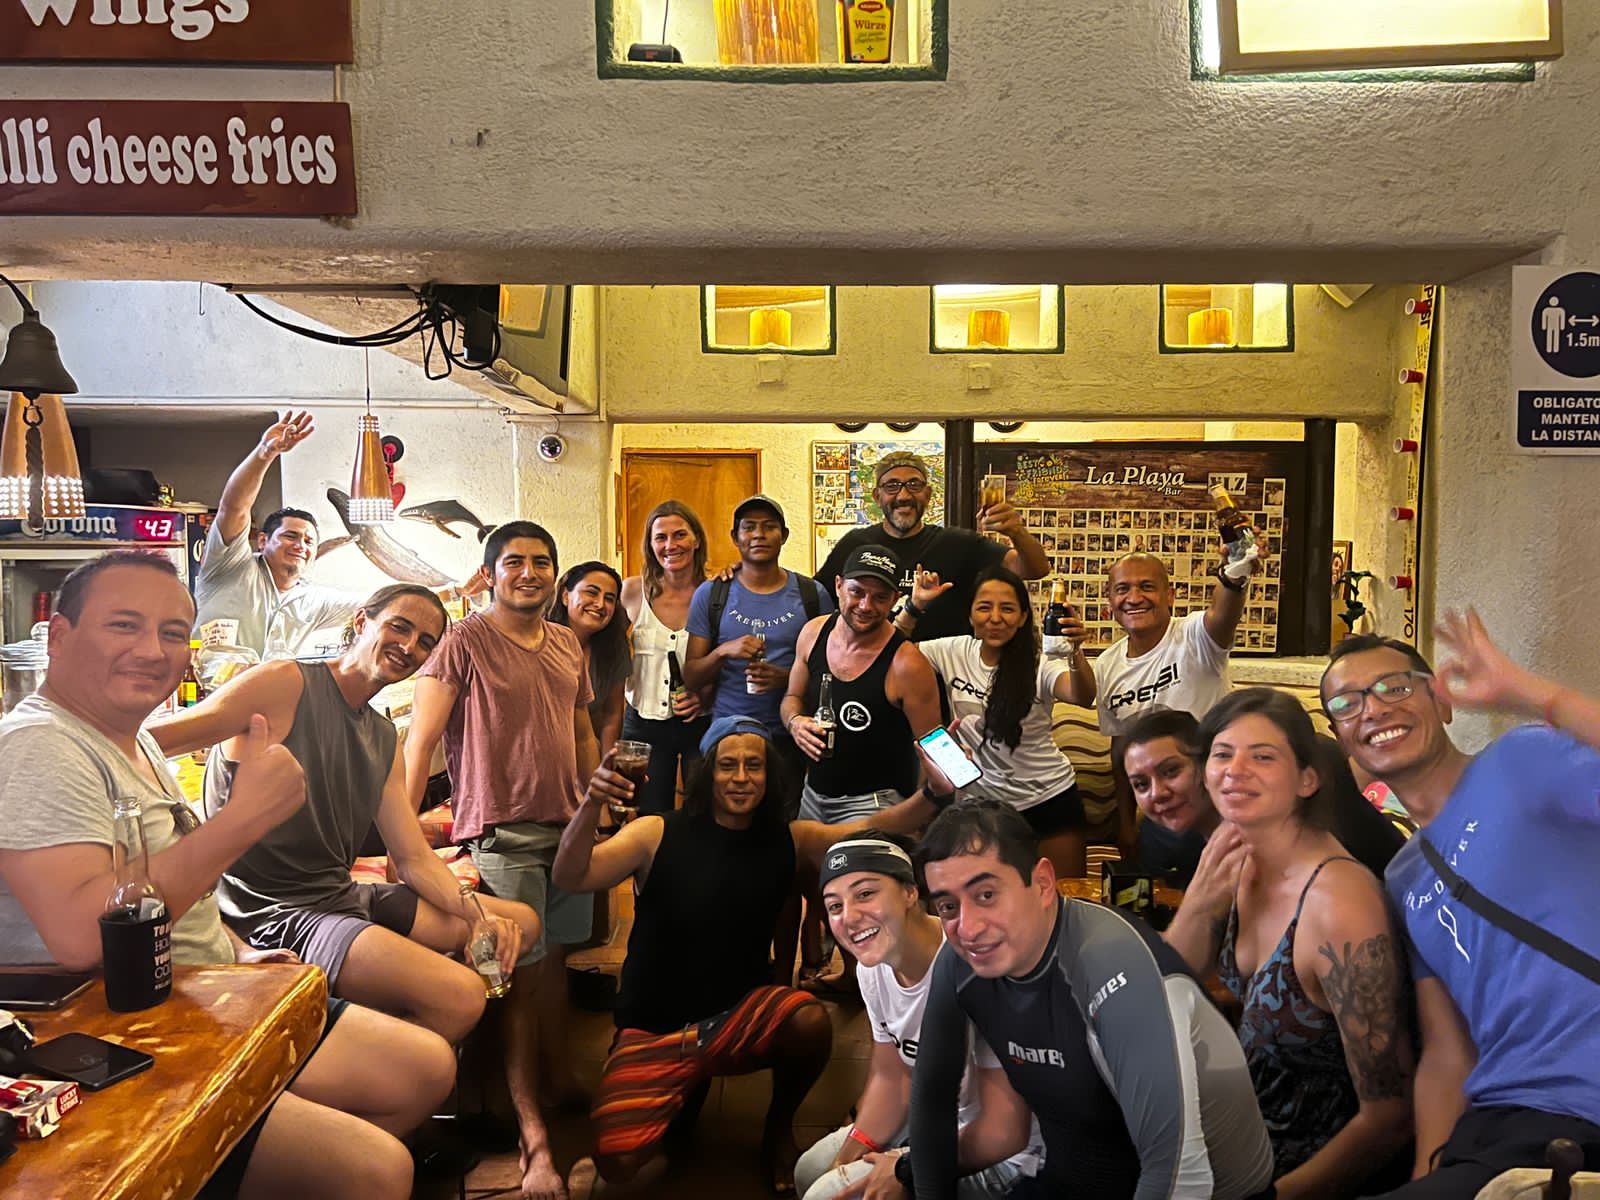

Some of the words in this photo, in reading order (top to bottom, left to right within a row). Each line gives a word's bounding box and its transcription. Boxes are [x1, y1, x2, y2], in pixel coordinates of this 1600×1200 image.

[854, 19, 886, 31] Würze
[0, 117, 58, 184] lli
[67, 117, 218, 185] cheese
[227, 116, 337, 185] fries
[1566, 333, 1600, 347] 1.5m
[1533, 397, 1600, 409] OBLIGATO
[1541, 413, 1600, 425] MANTEN
[1531, 429, 1549, 441] LA
[1553, 429, 1600, 441] DISTAN
[1084, 466, 1115, 485] La
[1121, 466, 1185, 491] Playa
[1164, 487, 1182, 496] Bar
[1403, 606, 1414, 639] 170
[1088, 971, 1128, 1017] mares
